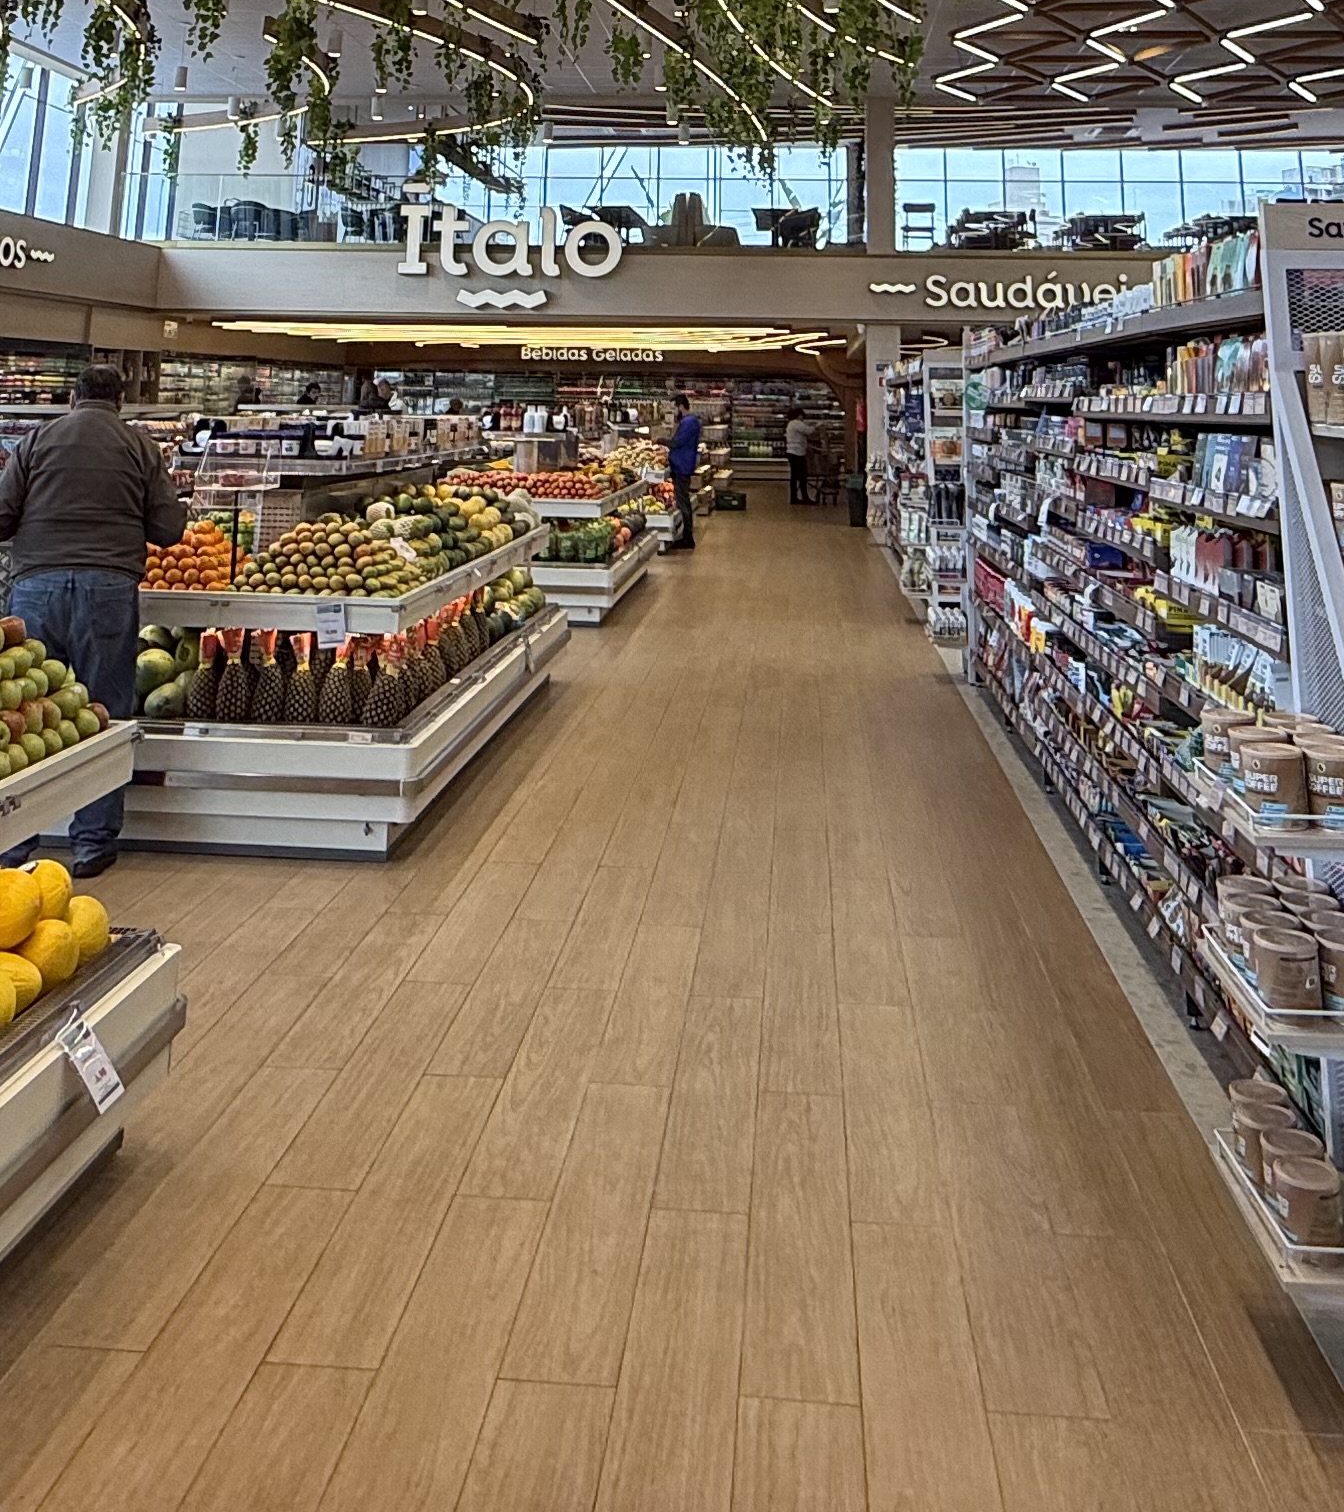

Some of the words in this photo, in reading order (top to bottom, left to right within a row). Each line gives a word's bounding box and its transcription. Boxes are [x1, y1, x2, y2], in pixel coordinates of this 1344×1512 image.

[925, 270, 1152, 308] Saudávei
[521, 346, 588, 361] Bebidas
[592, 347, 664, 362] Geladas
